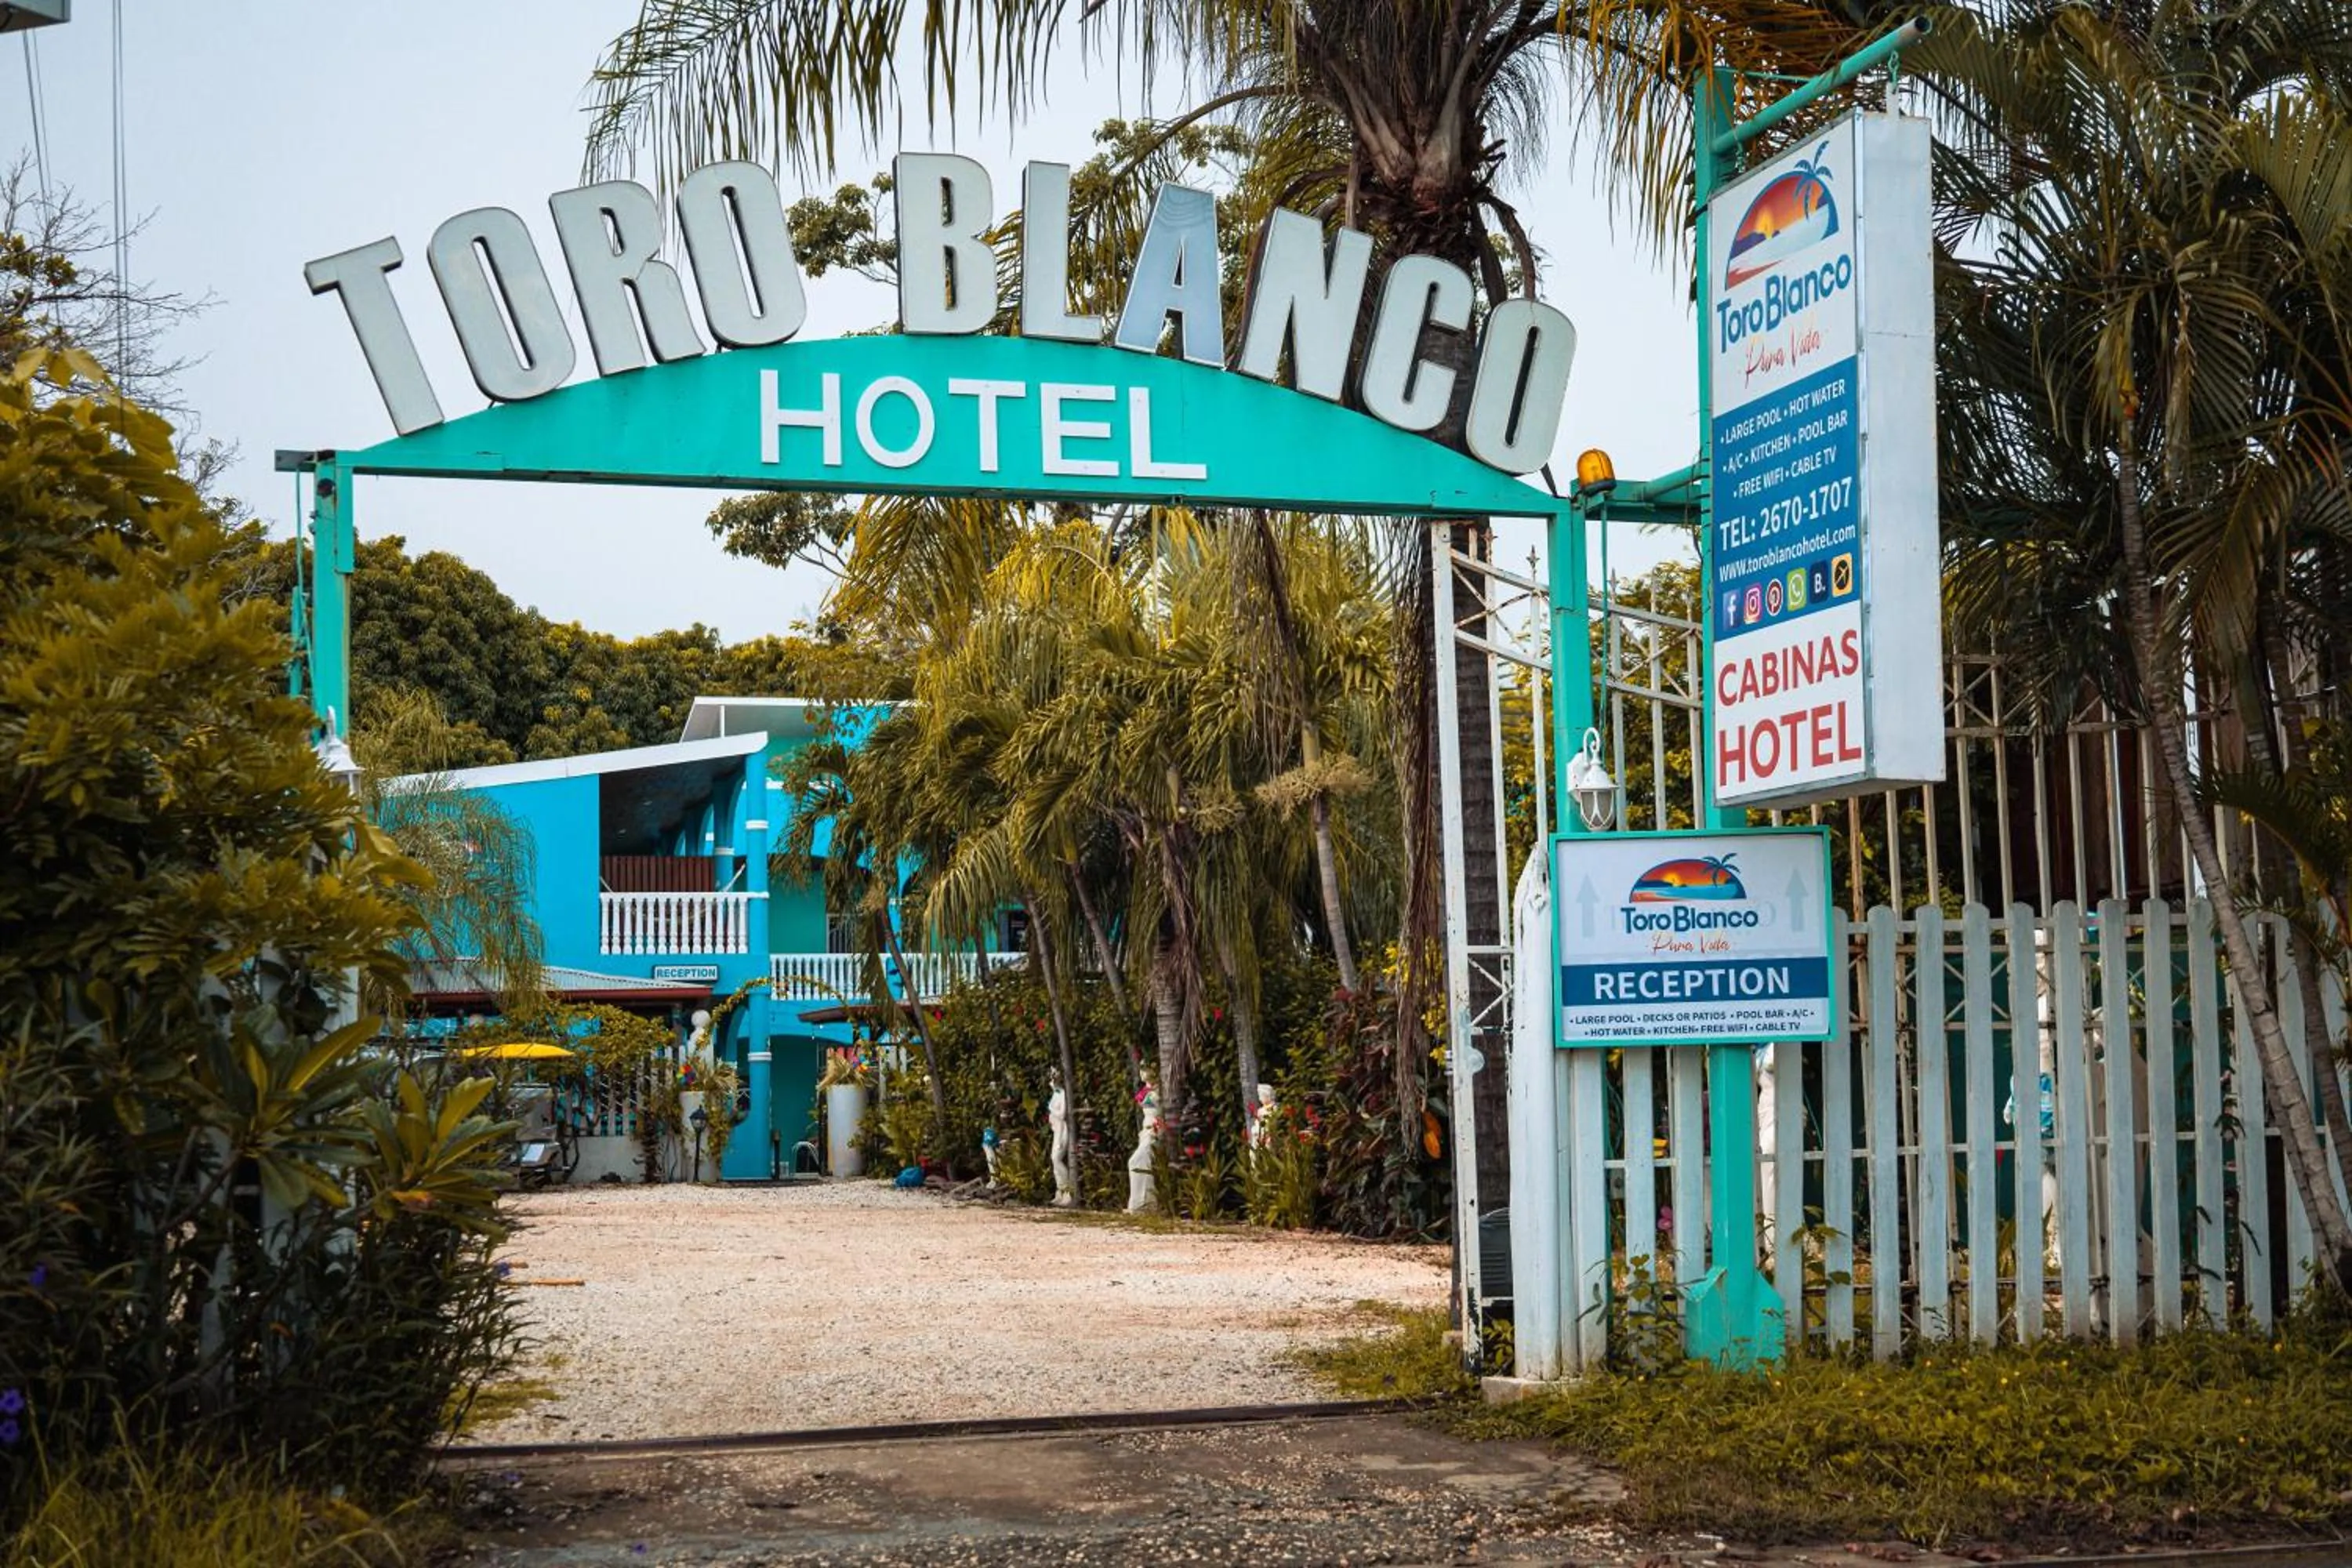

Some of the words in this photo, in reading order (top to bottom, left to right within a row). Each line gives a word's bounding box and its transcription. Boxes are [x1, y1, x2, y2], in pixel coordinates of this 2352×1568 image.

[303, 159, 808, 436] TORO
[892, 152, 1577, 475] BLANCO
[760, 369, 1207, 480] HOTEL
[1726, 418, 1755, 445] LARGE
[1757, 408, 1782, 430] POOL
[1789, 394, 1811, 416] HOT
[1813, 379, 1845, 407] WATER
[1728, 452, 1744, 474] A/C
[1751, 434, 1791, 463] KITCHEN
[1798, 420, 1825, 445] POOL
[1828, 409, 1848, 432] BAR
[1739, 474, 1762, 498] FREE
[1763, 466, 1784, 488] WIFI
[1791, 451, 1822, 477] CABLE
[1824, 445, 1837, 464] TV
[1719, 514, 1755, 551] TEL:
[1760, 476, 1852, 538] 2670-1707
[1718, 629, 1859, 706] CABINAS
[1719, 701, 1862, 786] HOTEL
[657, 968, 716, 978] RECEPTION
[1594, 967, 1790, 1000] RECEPTION
[1575, 1015, 1606, 1025] LARGE
[1608, 1014, 1635, 1023] POOL
[1642, 1013, 1675, 1022] DECKS
[1675, 1012, 1690, 1021] OR
[1693, 1011, 1726, 1020] PATIOS
[1737, 1011, 1763, 1019] POOL
[1765, 1009, 1784, 1018] BAR
[1791, 1008, 1808, 1018] A/C
[1591, 1028, 1610, 1036] HOT
[1612, 1027, 1646, 1036] WATER
[1653, 1025, 1695, 1035] KITCHEN
[1701, 1024, 1726, 1033] FREE
[1727, 1023, 1748, 1033] WIFI
[1755, 1022, 1786, 1032] CABLE
[1788, 1022, 1801, 1031] TV
